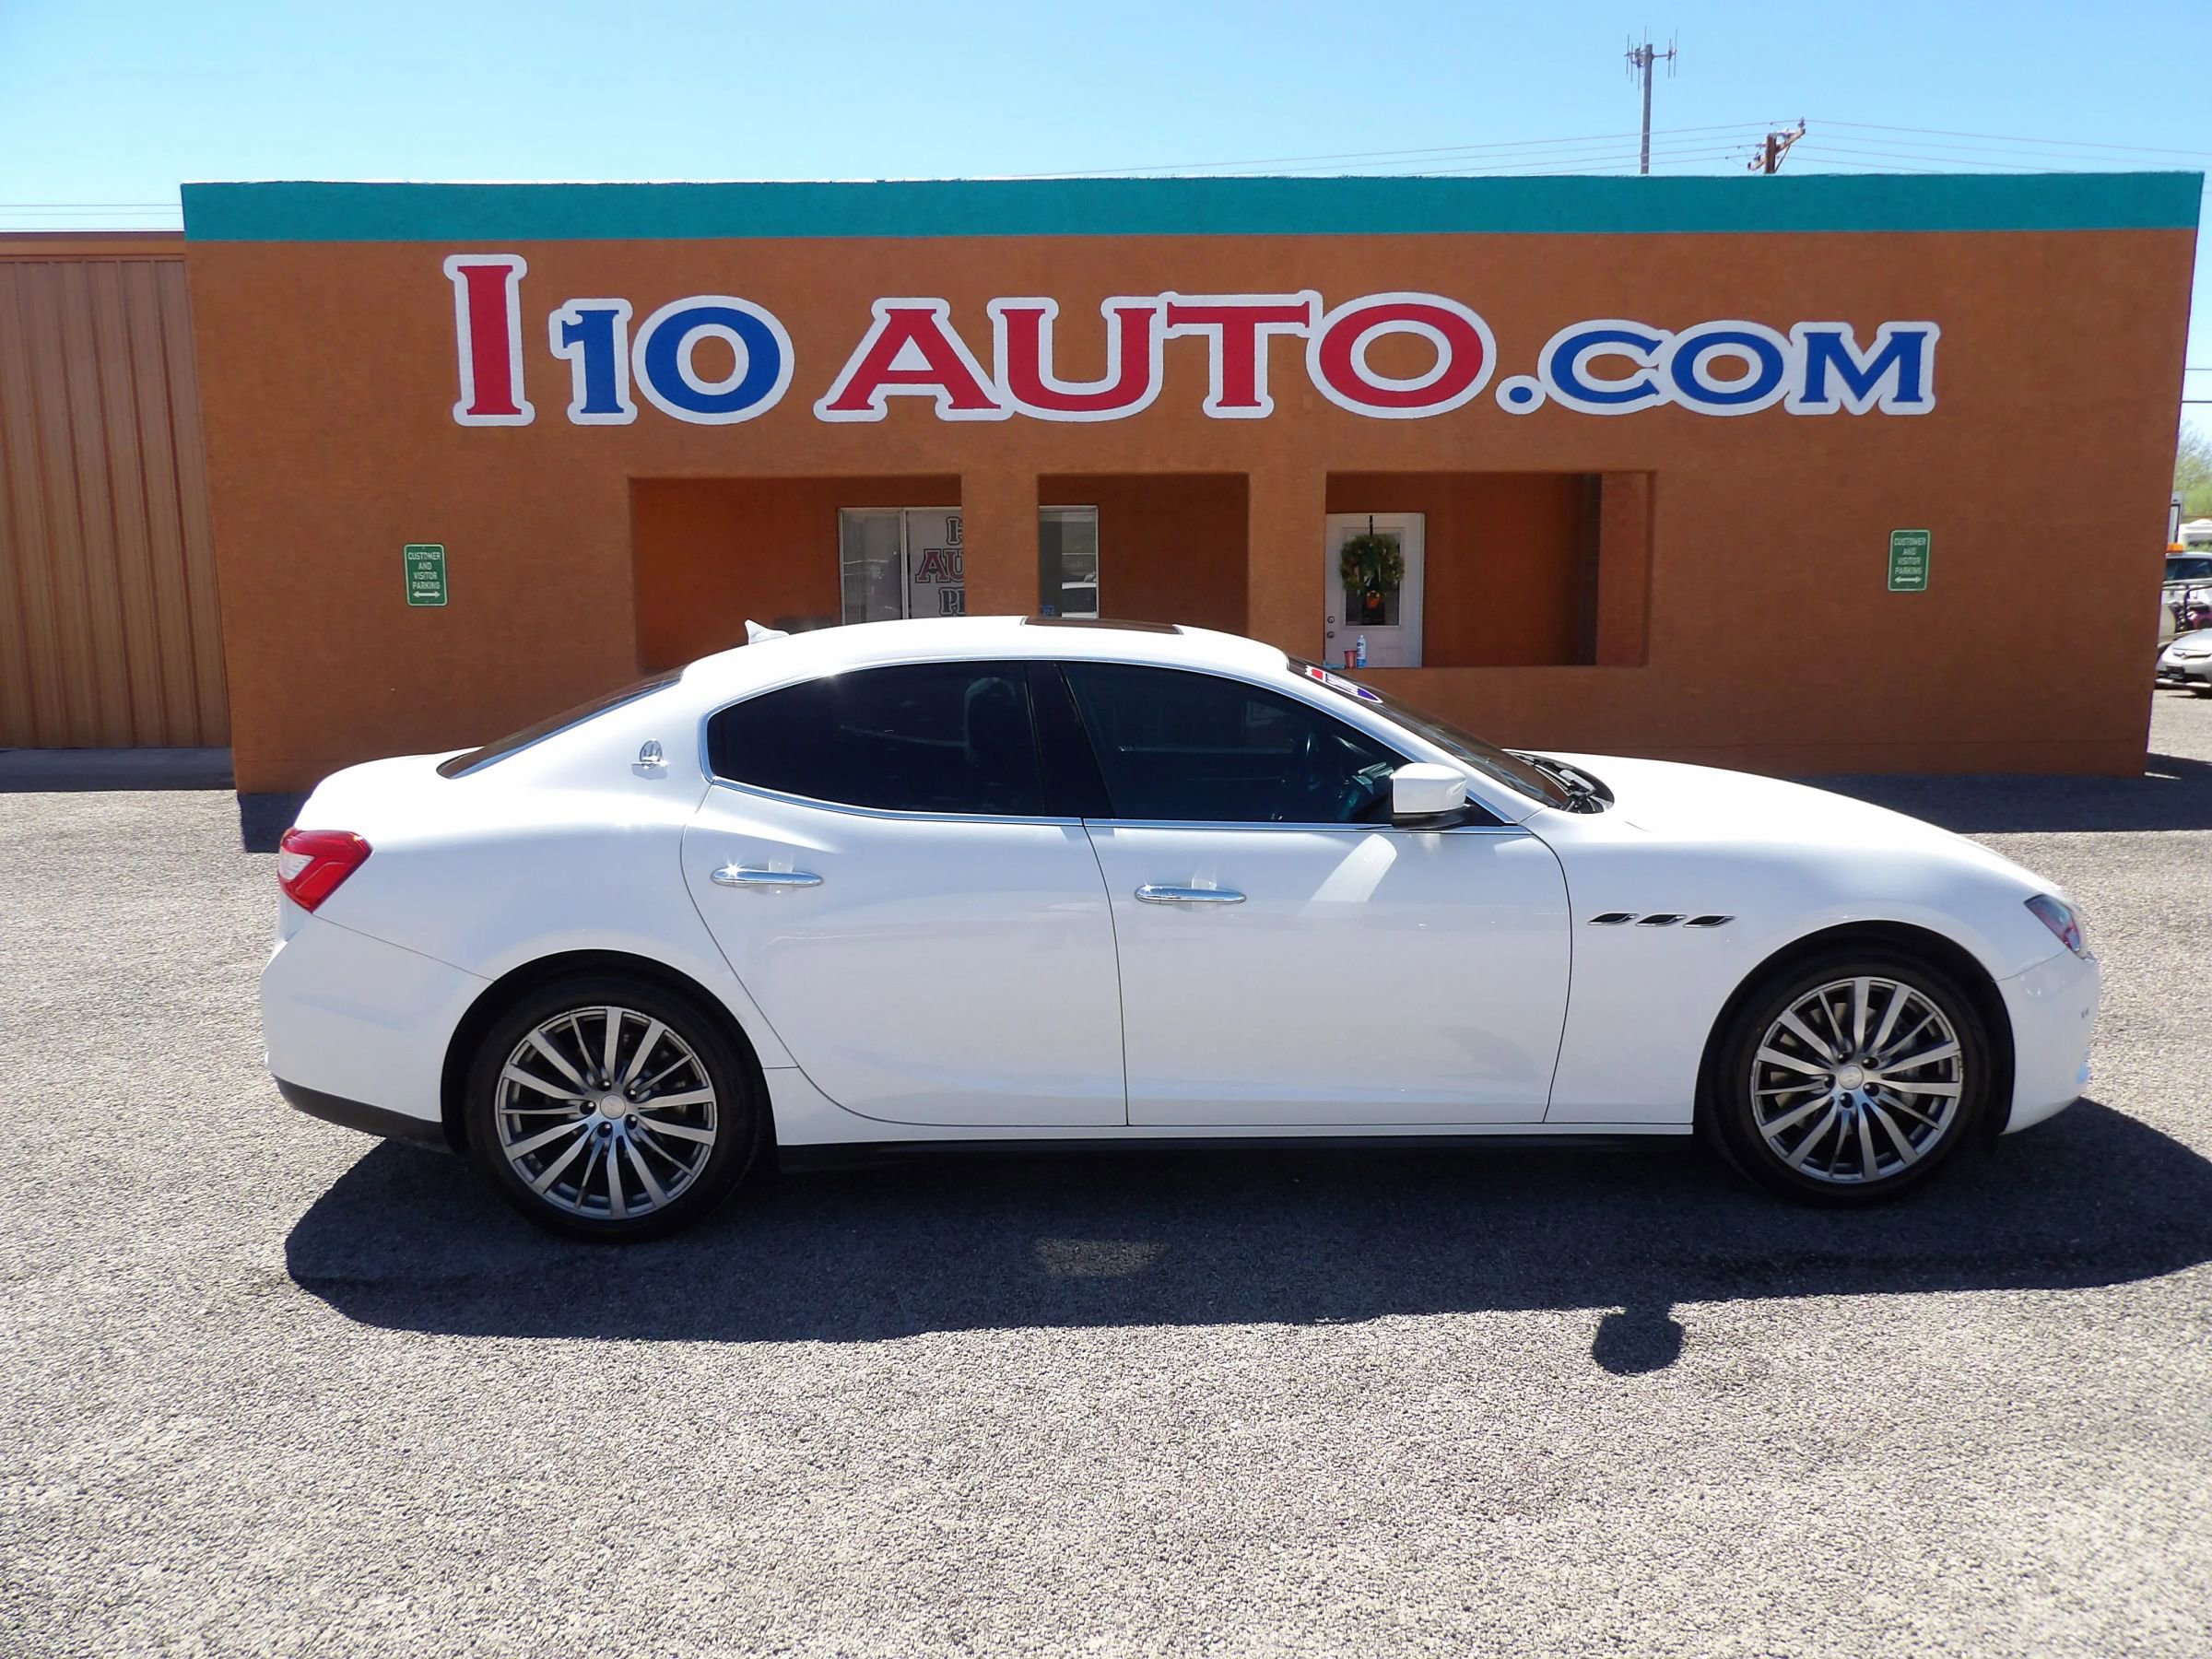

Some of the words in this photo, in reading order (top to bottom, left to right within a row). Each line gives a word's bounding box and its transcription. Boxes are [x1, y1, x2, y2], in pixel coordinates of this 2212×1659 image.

[1893, 537, 1926, 546] CUSTOMER
[407, 552, 441, 560] CUSTOMER
[1902, 547, 1917, 556] AND
[1897, 557, 1921, 565] VISITOR
[418, 561, 432, 571] AND
[413, 571, 438, 580] VISITOR
[1894, 567, 1923, 575] PARKING
[412, 581, 441, 590] PARKING
